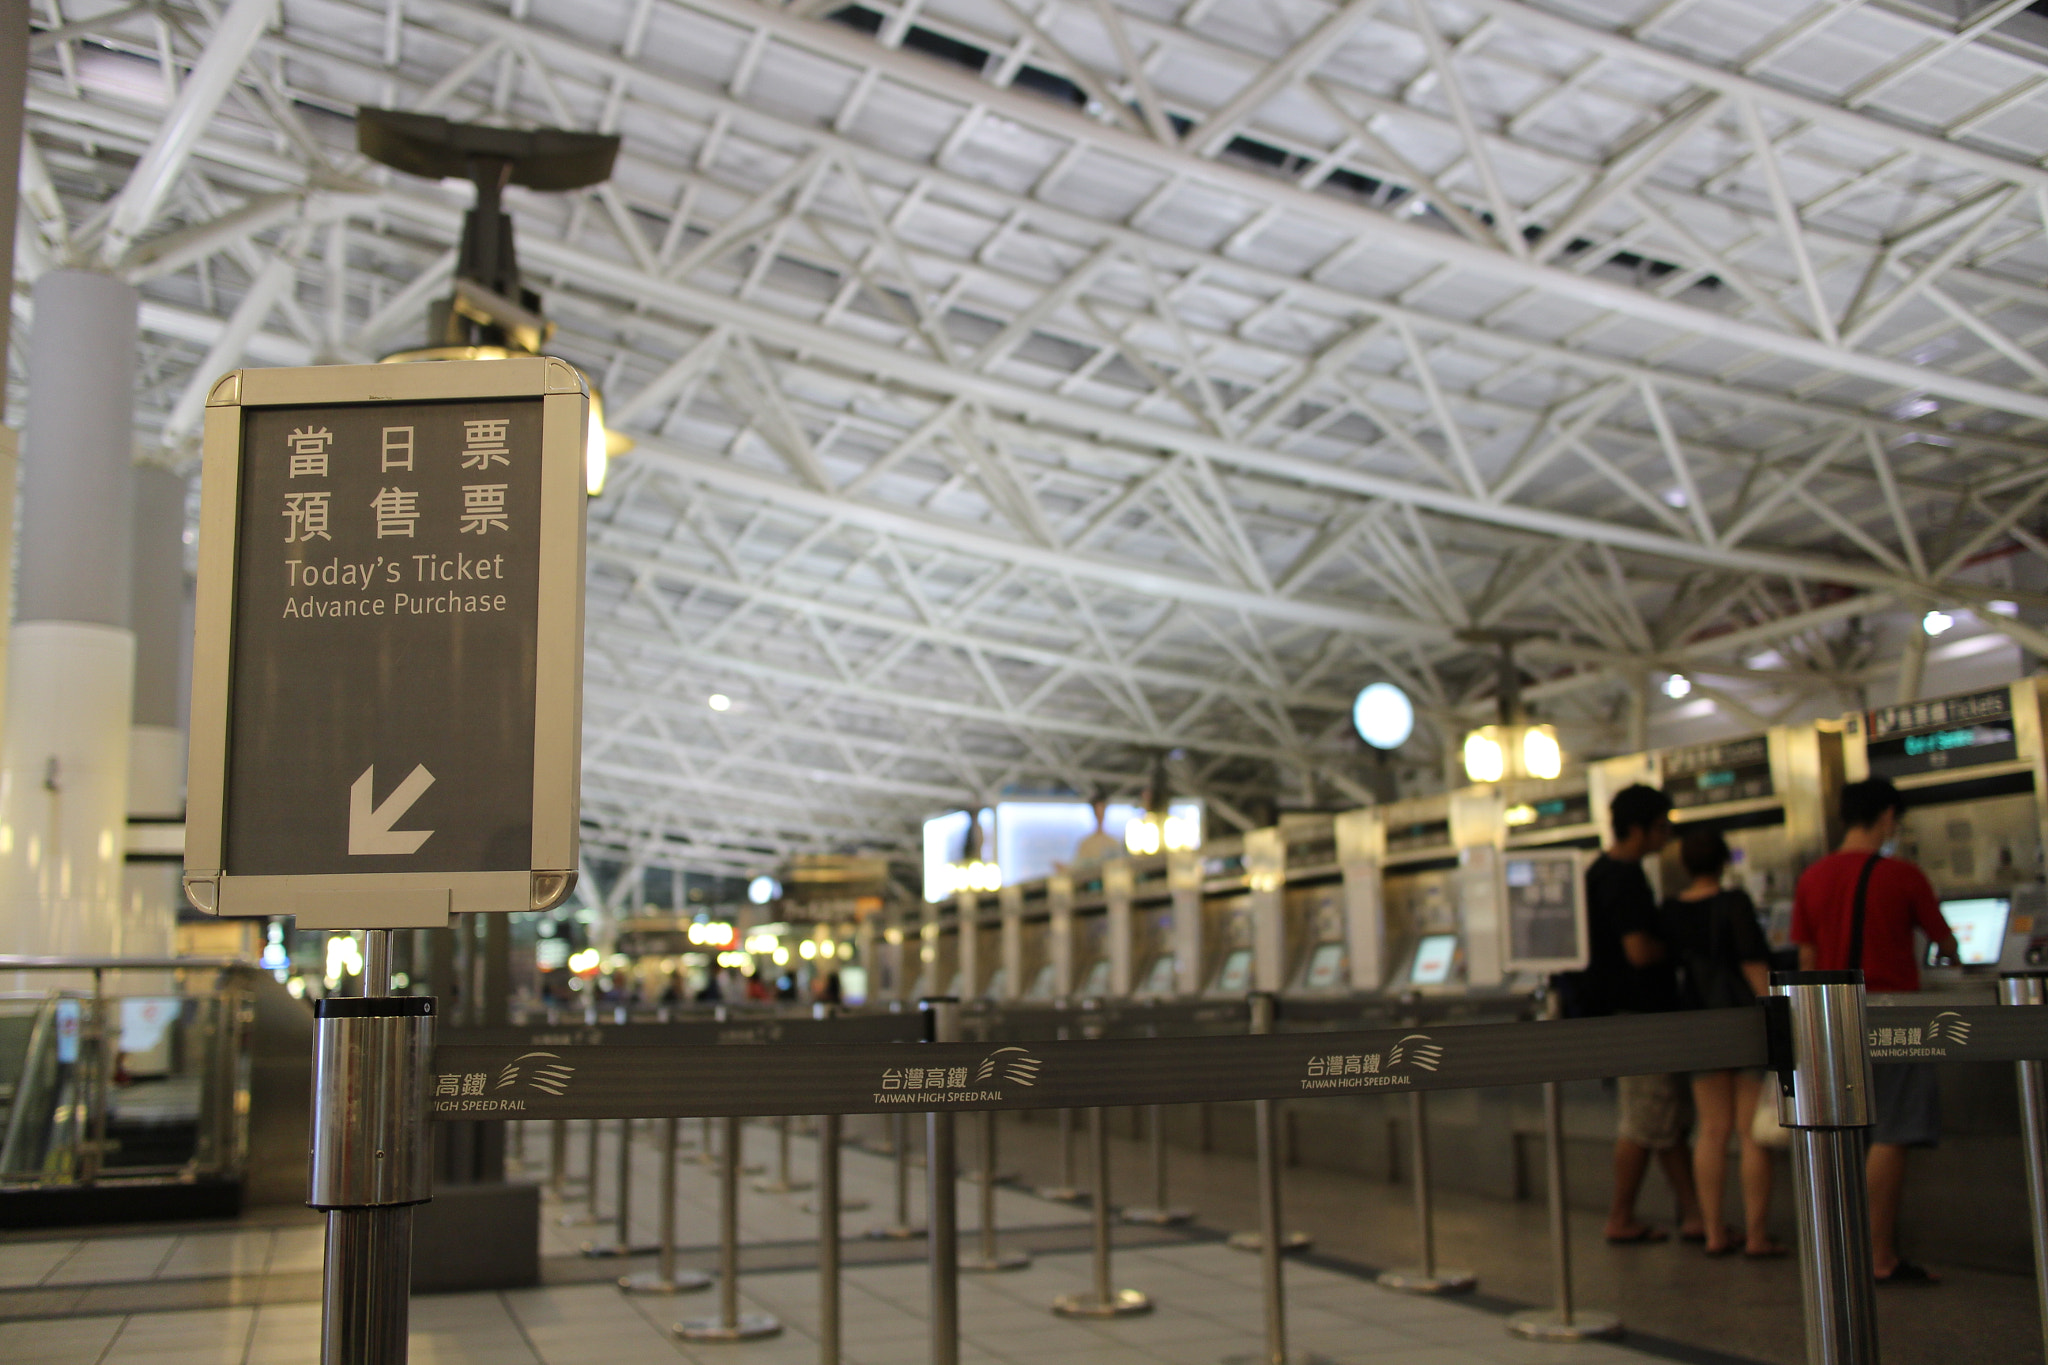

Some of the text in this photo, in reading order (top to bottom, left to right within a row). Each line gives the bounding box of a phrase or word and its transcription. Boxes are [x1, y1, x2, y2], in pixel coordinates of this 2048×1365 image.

[288, 419, 510, 478] 當日票
[282, 484, 509, 543] 預售票
[285, 552, 504, 590] Today’s Ticket
[283, 590, 507, 618] Advance Purchase
[1870, 1047, 1947, 1058] WAN HIGH SPEED RAIL
[1307, 1053, 1381, 1077] 台灣高鐵
[436, 1072, 488, 1096] 高鐵
[882, 1067, 968, 1090] 台灣高鐵
[1301, 1075, 1411, 1089] TAIWAN HIGH SPEED RAIL
[434, 1099, 527, 1112] IGH SPEED RAIL
[873, 1091, 1003, 1104] TAIWAN HIGH SPEED RAIL
